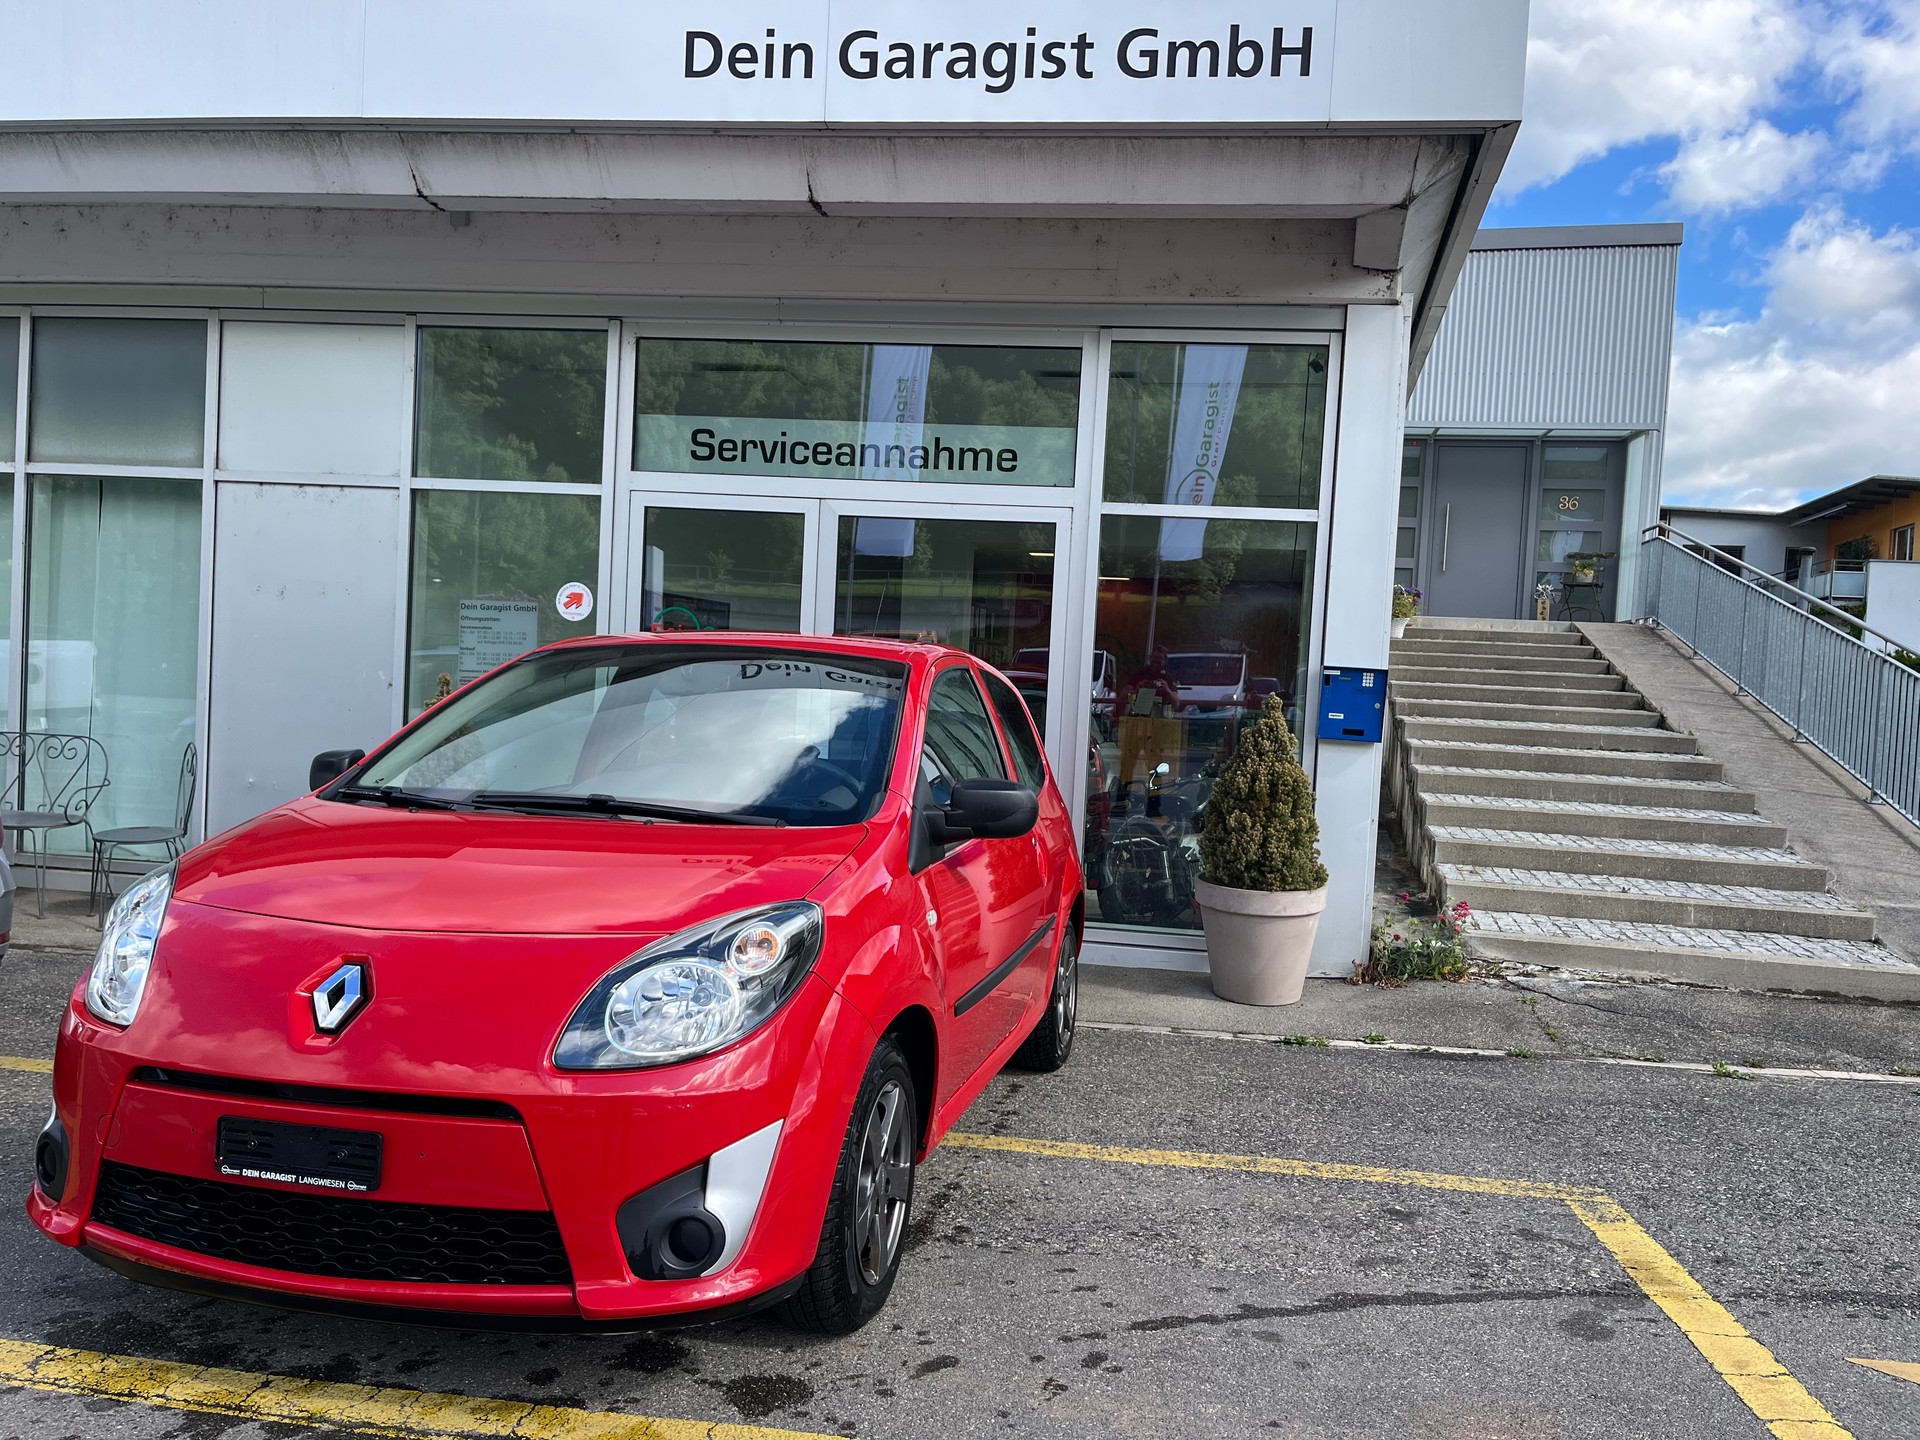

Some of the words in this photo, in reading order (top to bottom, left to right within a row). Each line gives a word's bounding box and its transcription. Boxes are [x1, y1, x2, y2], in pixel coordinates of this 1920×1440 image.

[683, 28, 814, 80] Dein
[837, 27, 1095, 94] Garagist
[1115, 24, 1315, 79] GmbH
[1195, 381, 1220, 468] Garagist
[690, 427, 1019, 473] Serviceannahme
[1190, 475, 1206, 505] ein
[1558, 495, 1580, 511] 36
[460, 602, 478, 610] Dein
[479, 603, 512, 613] Garagist
[513, 604, 537, 612] GmbH
[241, 1168, 260, 1178] DEIN
[260, 1171, 297, 1183] GARAGIST
[299, 1175, 346, 1189] LANGWIESEN
